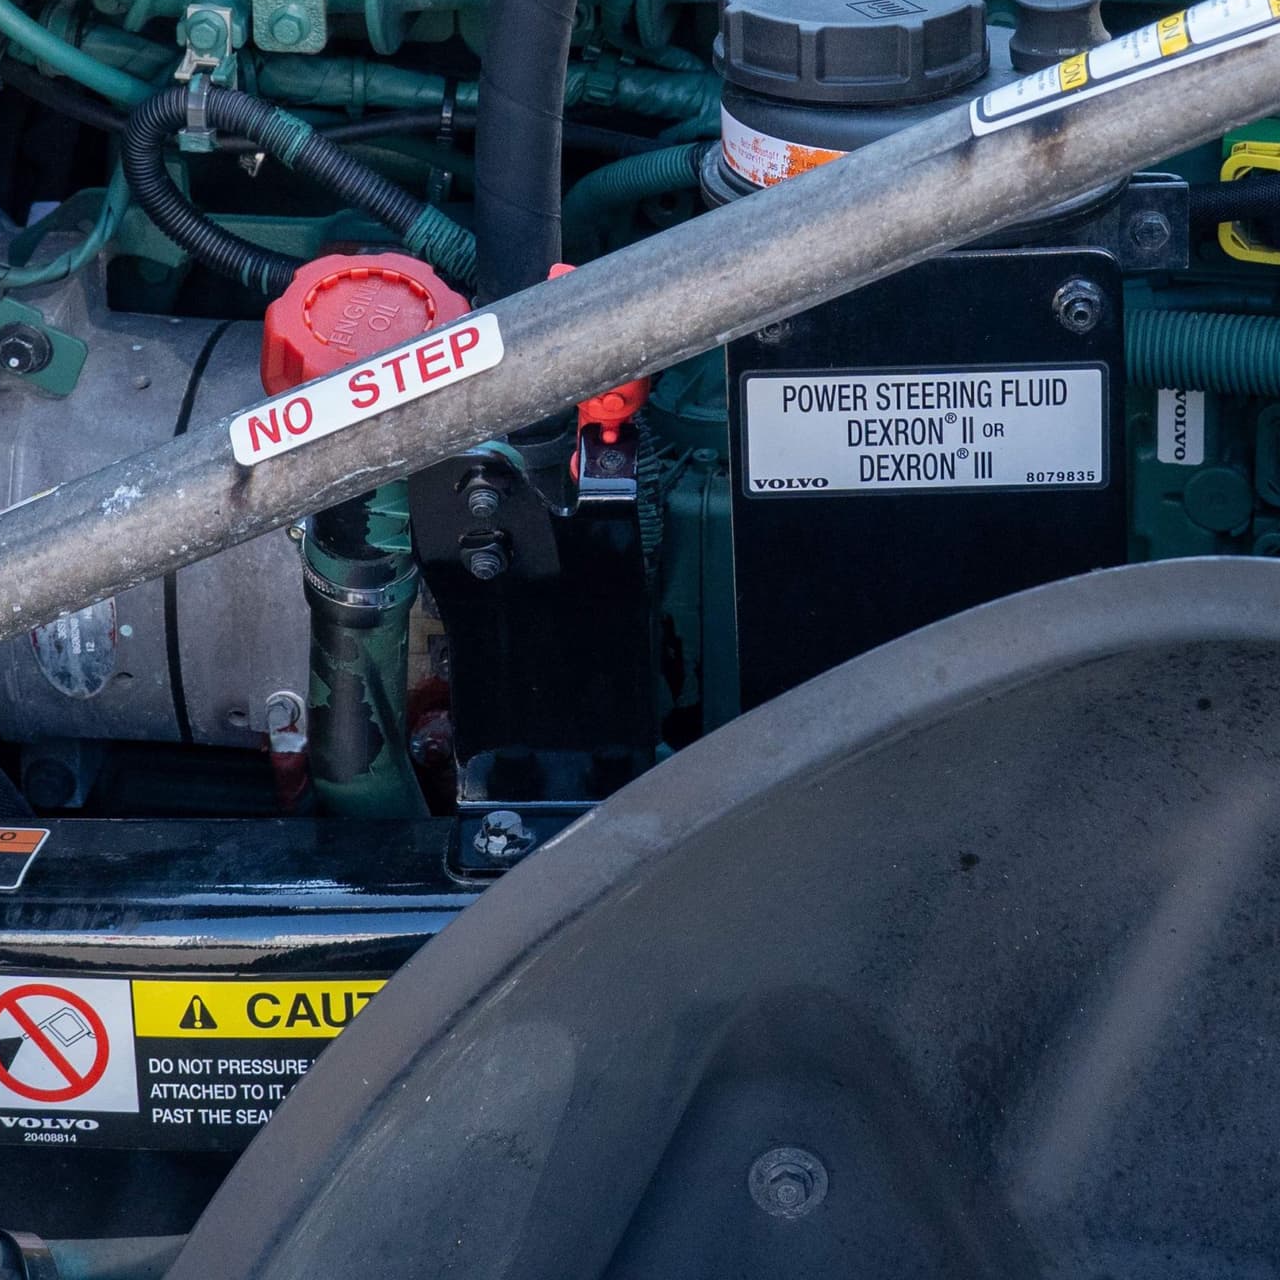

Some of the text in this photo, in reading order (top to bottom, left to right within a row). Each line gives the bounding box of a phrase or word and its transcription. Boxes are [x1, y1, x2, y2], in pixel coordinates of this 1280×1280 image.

[329, 276, 383, 348] ENGINE
[368, 303, 402, 332] OIL
[247, 326, 480, 453] NO STEP
[782, 377, 1068, 414] POWER STEERING FLUID
[962, 416, 975, 444] II
[982, 422, 1005, 439] OR
[1174, 391, 1187, 460] VOLVO
[974, 451, 993, 480] III
[754, 471, 1096, 490] VOLVO 8079835
[148, 1057, 308, 1075] DO NOT PRESSURE
[149, 1083, 287, 1100] ATTACHED TO IT.
[152, 1107, 195, 1124] PAST
[197, 1108, 233, 1125] THE
[23, 1130, 78, 1144] 20408814
